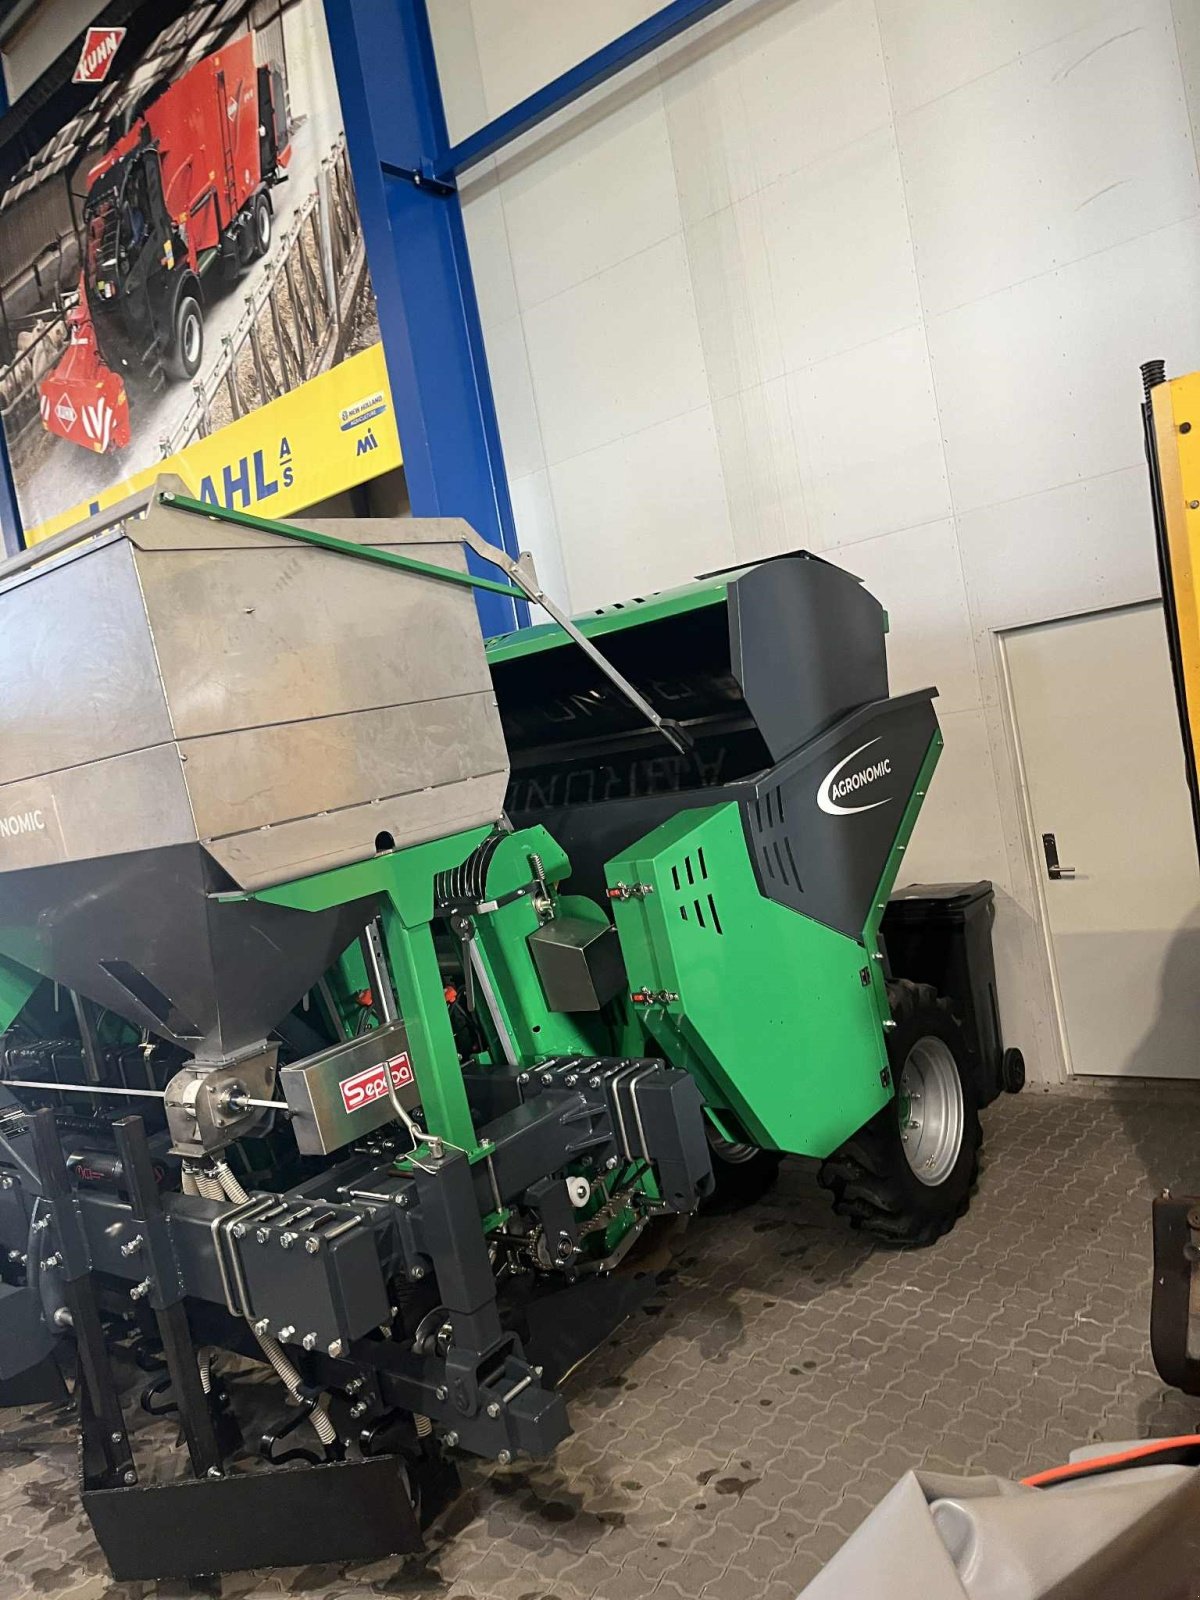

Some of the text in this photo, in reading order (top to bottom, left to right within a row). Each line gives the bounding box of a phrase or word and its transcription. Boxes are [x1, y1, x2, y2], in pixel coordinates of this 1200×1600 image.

[78, 32, 118, 80] KUHN
[348, 395, 383, 416] NEW HOLLAND
[832, 758, 892, 801] AGRONOMIC
